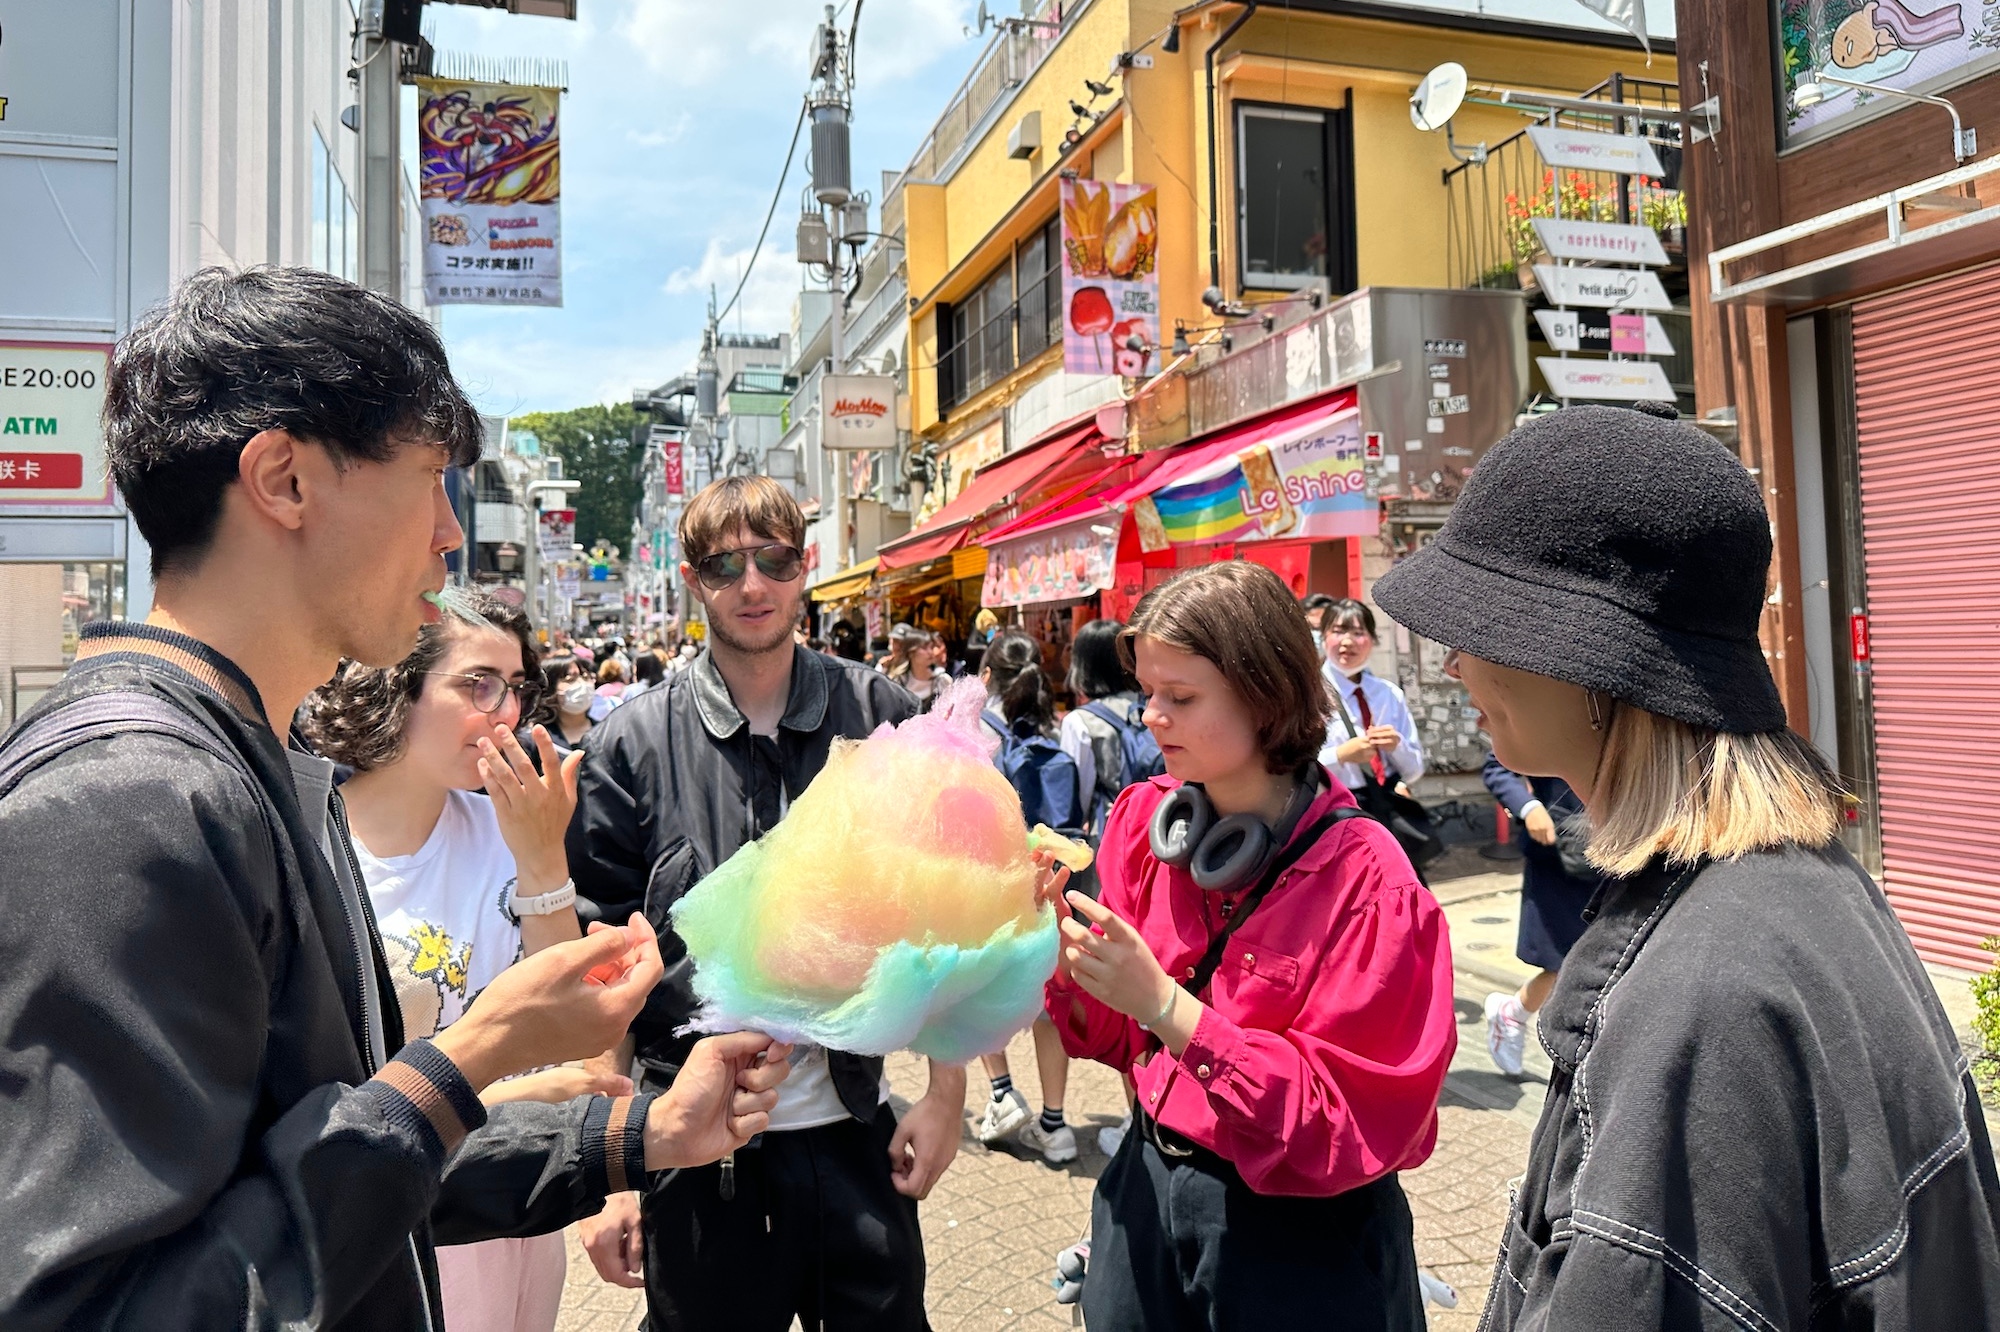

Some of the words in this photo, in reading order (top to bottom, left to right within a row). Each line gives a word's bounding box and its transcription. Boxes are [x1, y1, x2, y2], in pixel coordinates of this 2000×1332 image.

[1567, 234, 1637, 253] northerly
[446, 256, 534, 270] コラボ実施!!
[1579, 284, 1601, 295] Petit
[1603, 285, 1628, 297] glam
[0, 368, 18, 387] E
[22, 368, 96, 389] 20:00
[3, 417, 57, 435] ATM
[843, 419, 875, 428] モモン
[1239, 488, 1279, 516] Le
[1285, 470, 1366, 506] Shine
